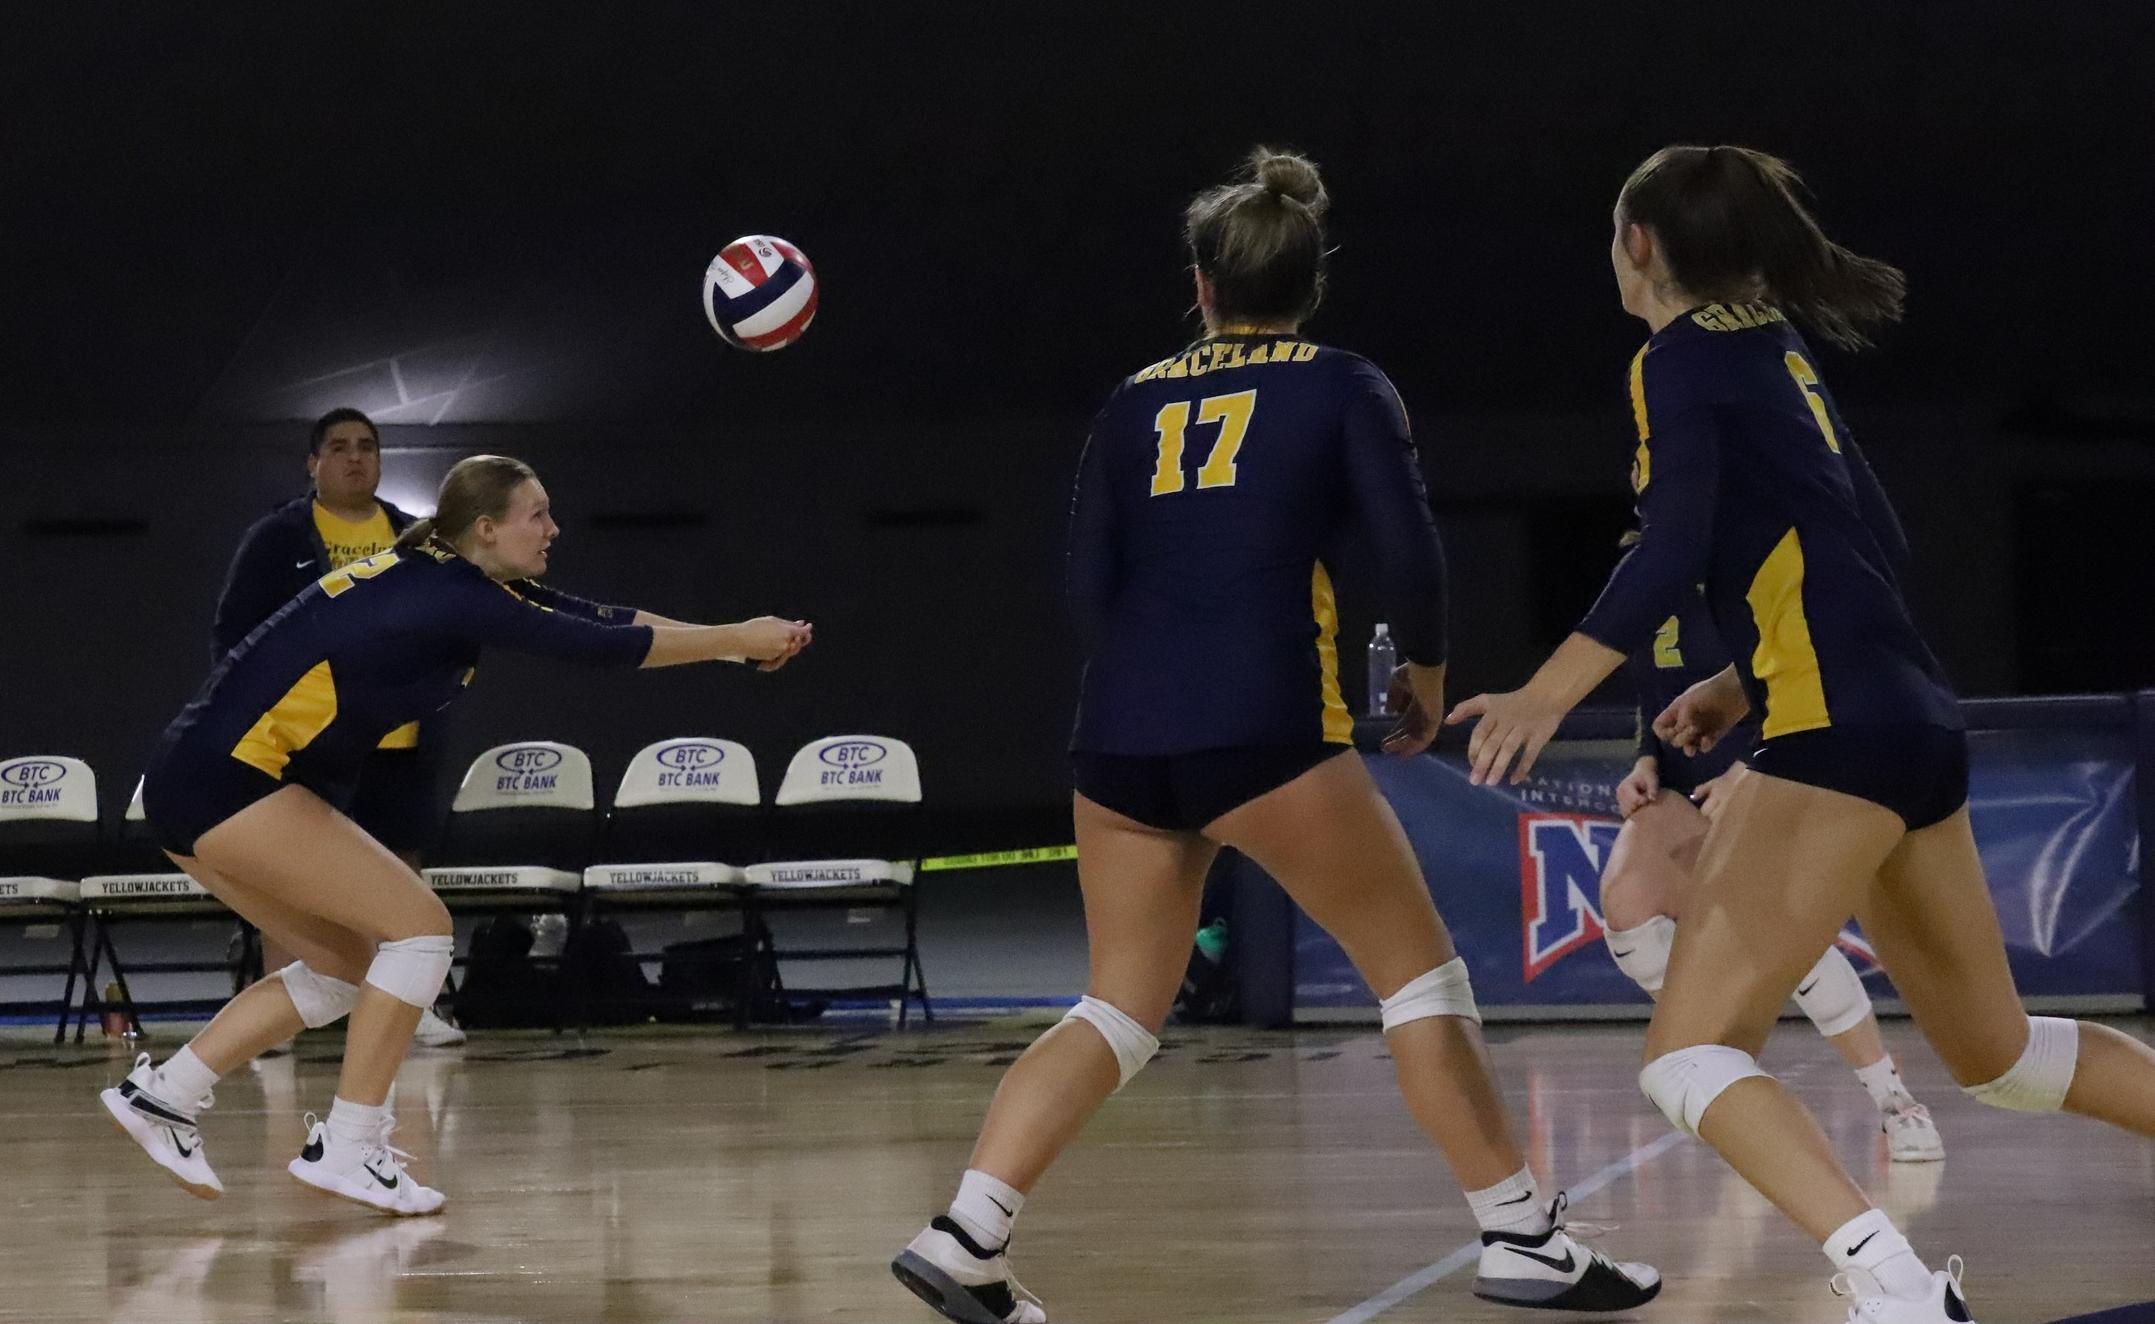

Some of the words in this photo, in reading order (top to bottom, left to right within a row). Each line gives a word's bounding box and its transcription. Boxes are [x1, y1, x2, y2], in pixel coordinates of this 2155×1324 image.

[1150, 388, 1257, 497] 17
[1653, 615, 1684, 668] 2
[514, 752, 546, 767] BTC
[675, 749, 708, 763] BTC
[838, 746, 870, 761] BTC
[19, 766, 50, 780] BTC
[658, 773, 683, 786] BTC
[686, 772, 721, 786] BANK
[820, 771, 846, 785] BTC
[848, 769, 884, 784] BANK
[497, 777, 522, 790] BTC
[524, 776, 557, 789] BANK
[2, 789, 26, 803] BTC
[28, 787, 62, 803] BANK
[430, 873, 518, 885] YELLOWJACKETS
[609, 870, 699, 884] YELLOWJACKETS
[771, 868, 861, 882] YELLOWJACKETS
[102, 881, 190, 894] YELLOWJACKETS
